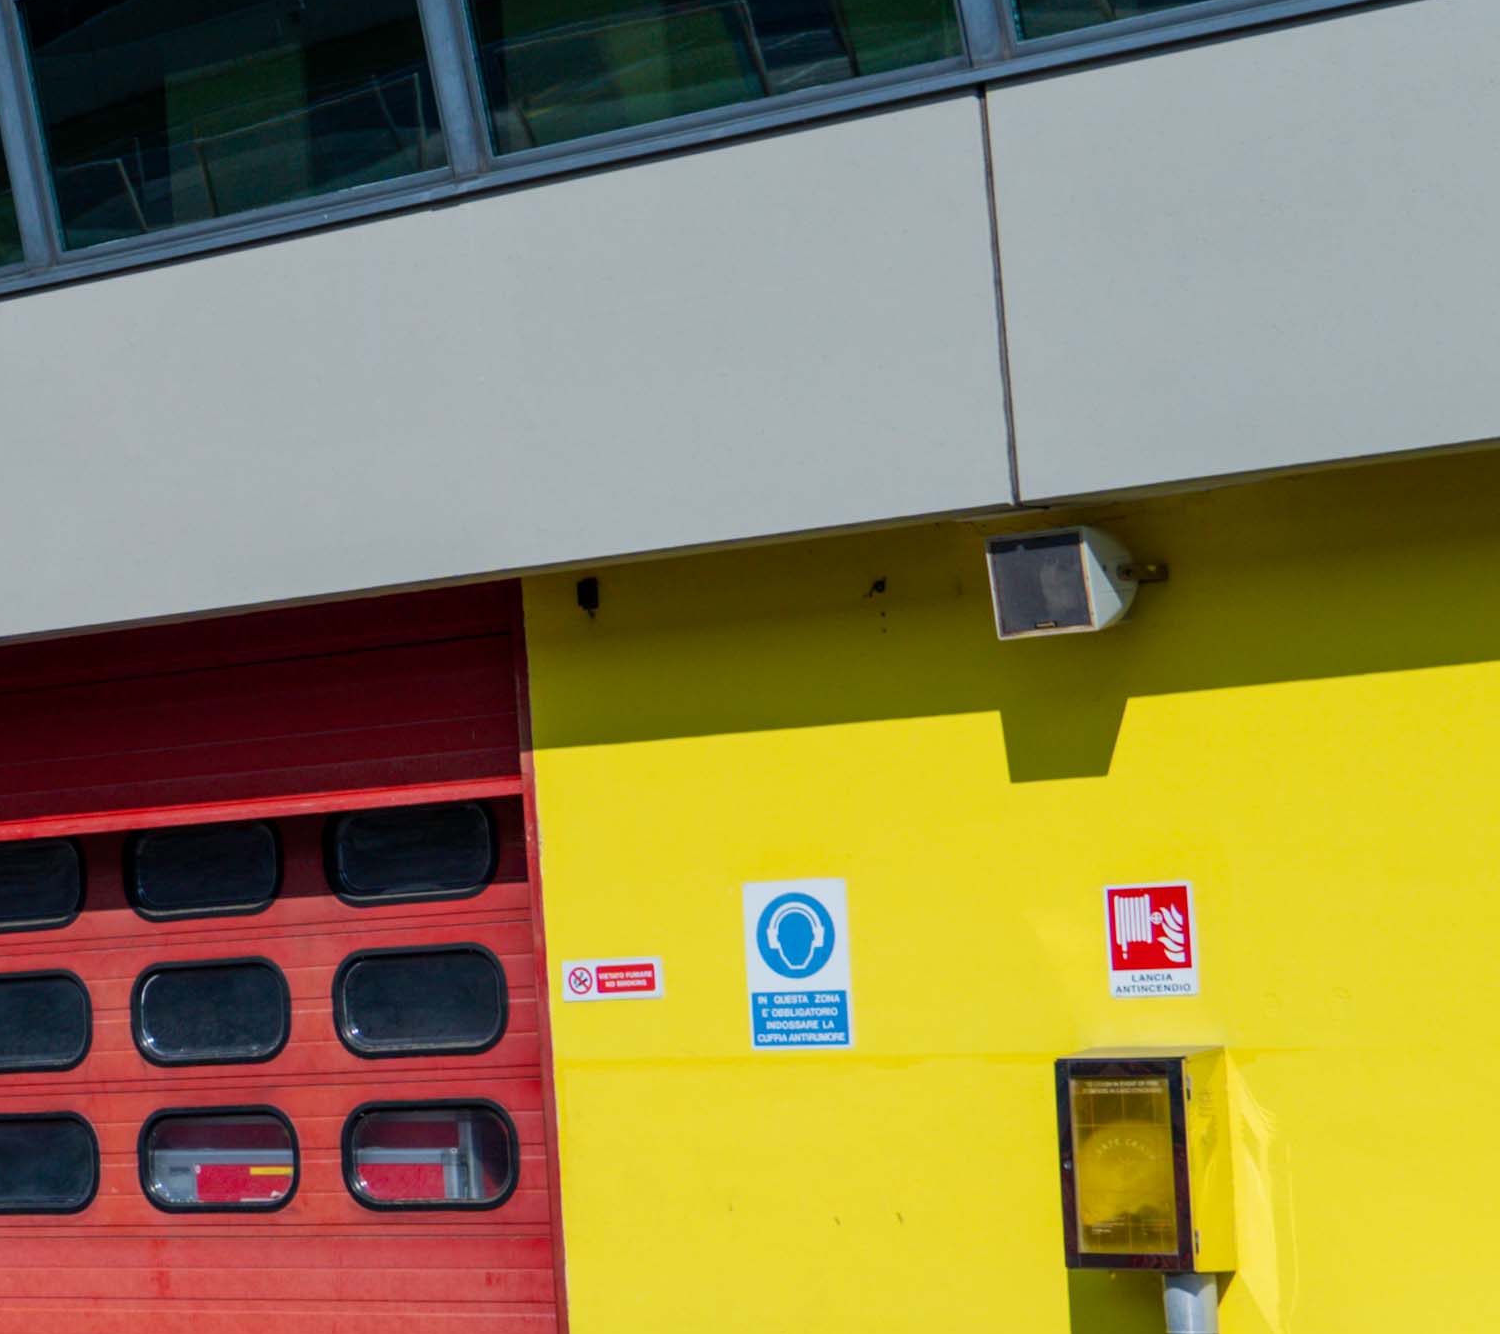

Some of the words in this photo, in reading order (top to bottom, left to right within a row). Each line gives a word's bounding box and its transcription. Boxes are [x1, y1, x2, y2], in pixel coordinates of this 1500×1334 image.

[1131, 973, 1173, 983] LANCIA
[1116, 983, 1192, 993] ANTINCENDIO
[757, 995, 768, 1005] IN
[773, 994, 809, 1004] QUESTA
[814, 994, 841, 1004] ZONA
[771, 1007, 838, 1017] OBBLIGATORIO
[766, 1020, 819, 1030] INDOSSARE
[822, 1020, 835, 1029] LA
